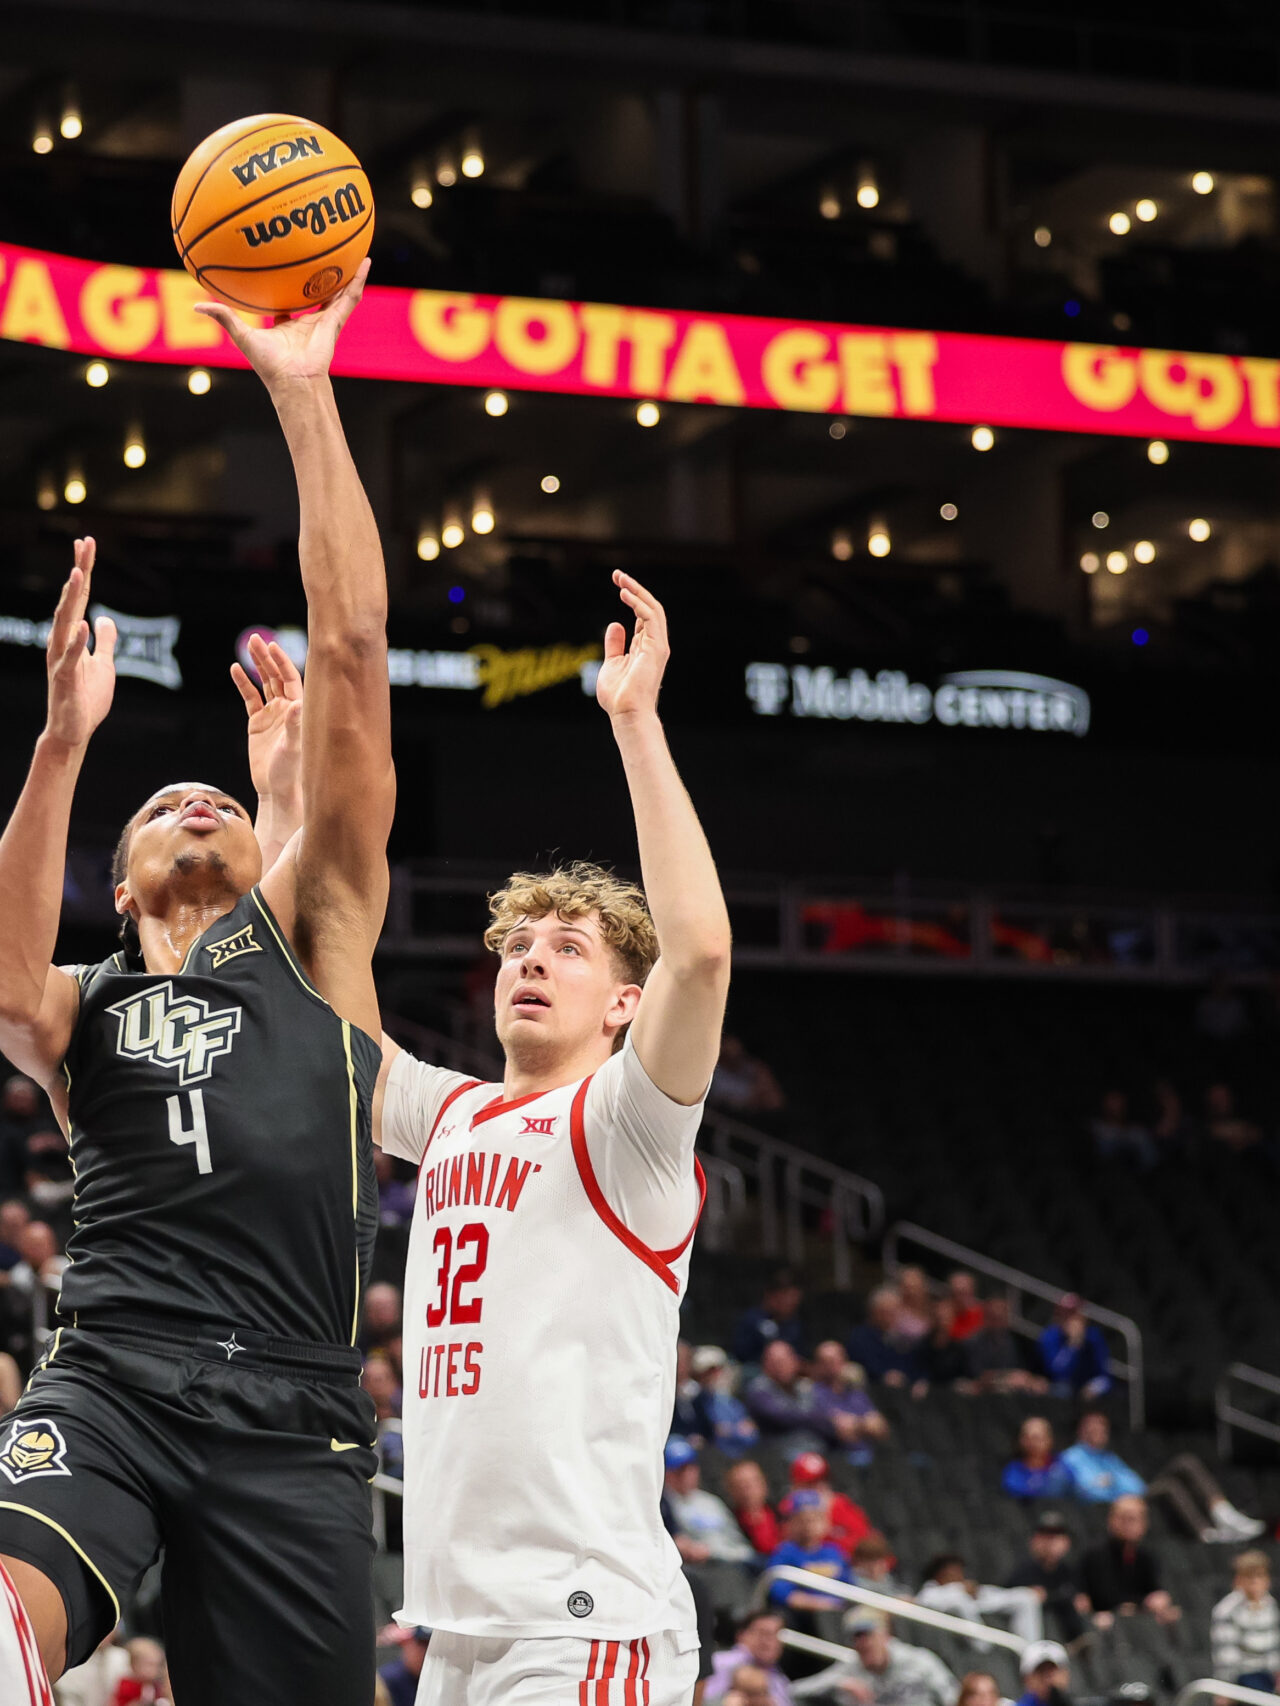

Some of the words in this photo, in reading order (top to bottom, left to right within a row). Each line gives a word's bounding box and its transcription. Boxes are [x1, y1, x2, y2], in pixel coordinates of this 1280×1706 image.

[231, 135, 324, 187] NCAA
[240, 182, 367, 247] Wilson
[80, 264, 262, 355] GE
[409, 289, 746, 407] GOTTA
[761, 328, 938, 417] GET
[792, 665, 933, 724] Mobile
[934, 684, 1073, 731] CENTER
[112, 984, 240, 1083] UCF
[166, 1088, 213, 1175] 4
[426, 1151, 542, 1221] RUNNIN'
[426, 1222, 490, 1328] 32
[419, 1341, 484, 1399] UTES
